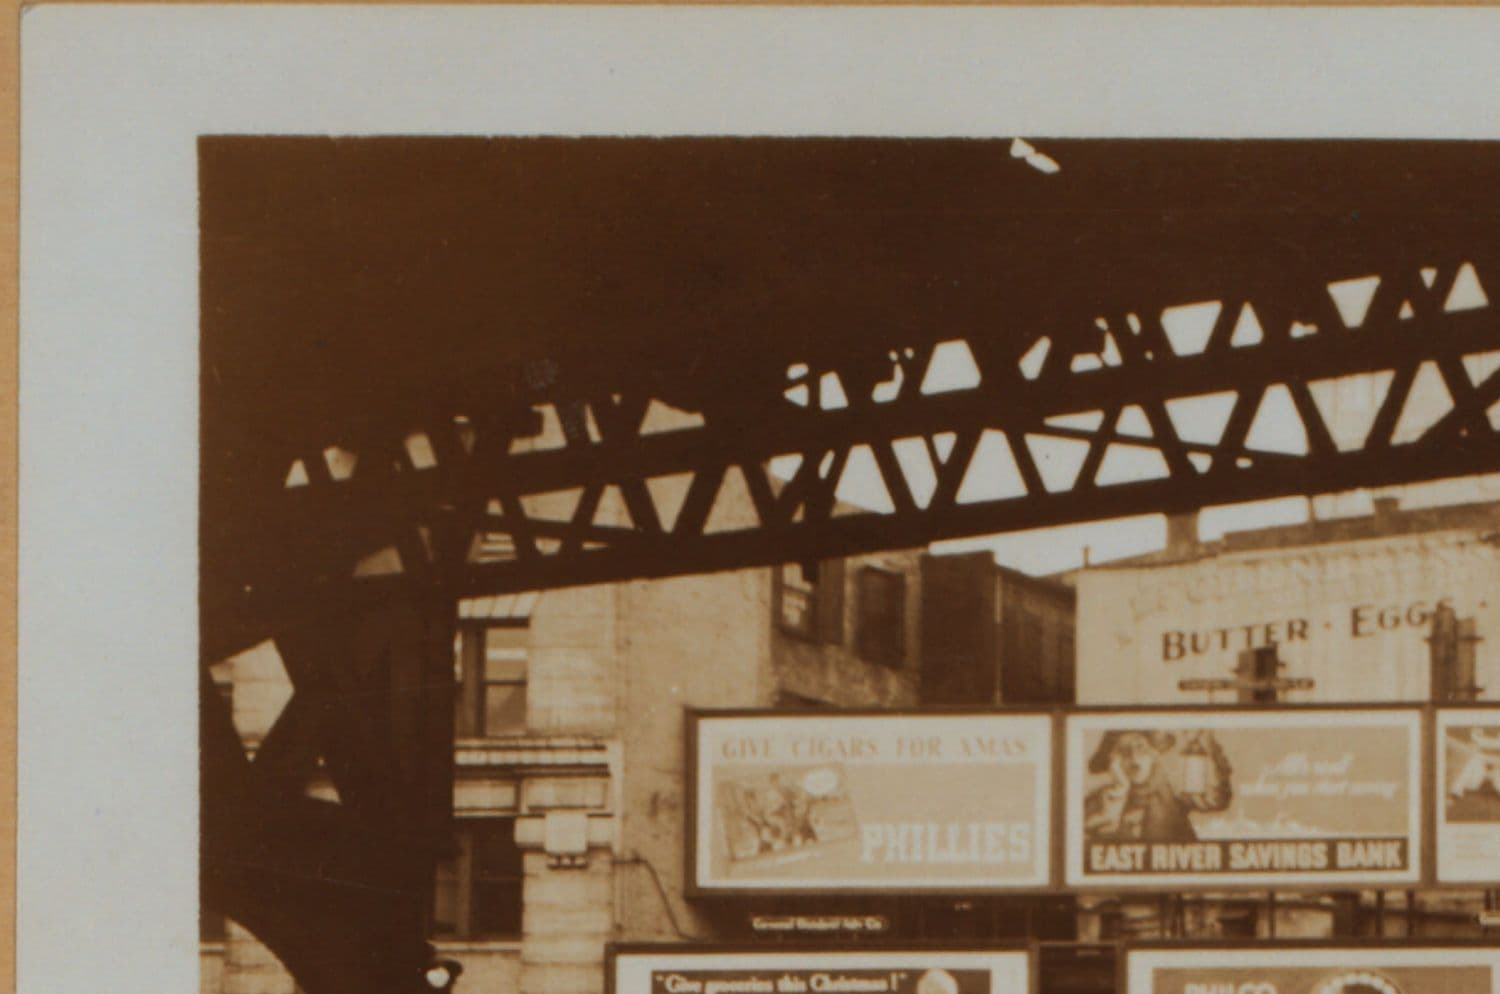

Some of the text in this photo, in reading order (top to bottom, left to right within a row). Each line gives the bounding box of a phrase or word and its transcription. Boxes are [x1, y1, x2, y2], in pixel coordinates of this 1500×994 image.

[1162, 618, 1310, 662] BUTTER
[792, 735, 880, 759] CIGARS
[860, 821, 1031, 864] PHILLIES
[1090, 840, 1403, 871] EAST RIVER SAVINGS BANK
